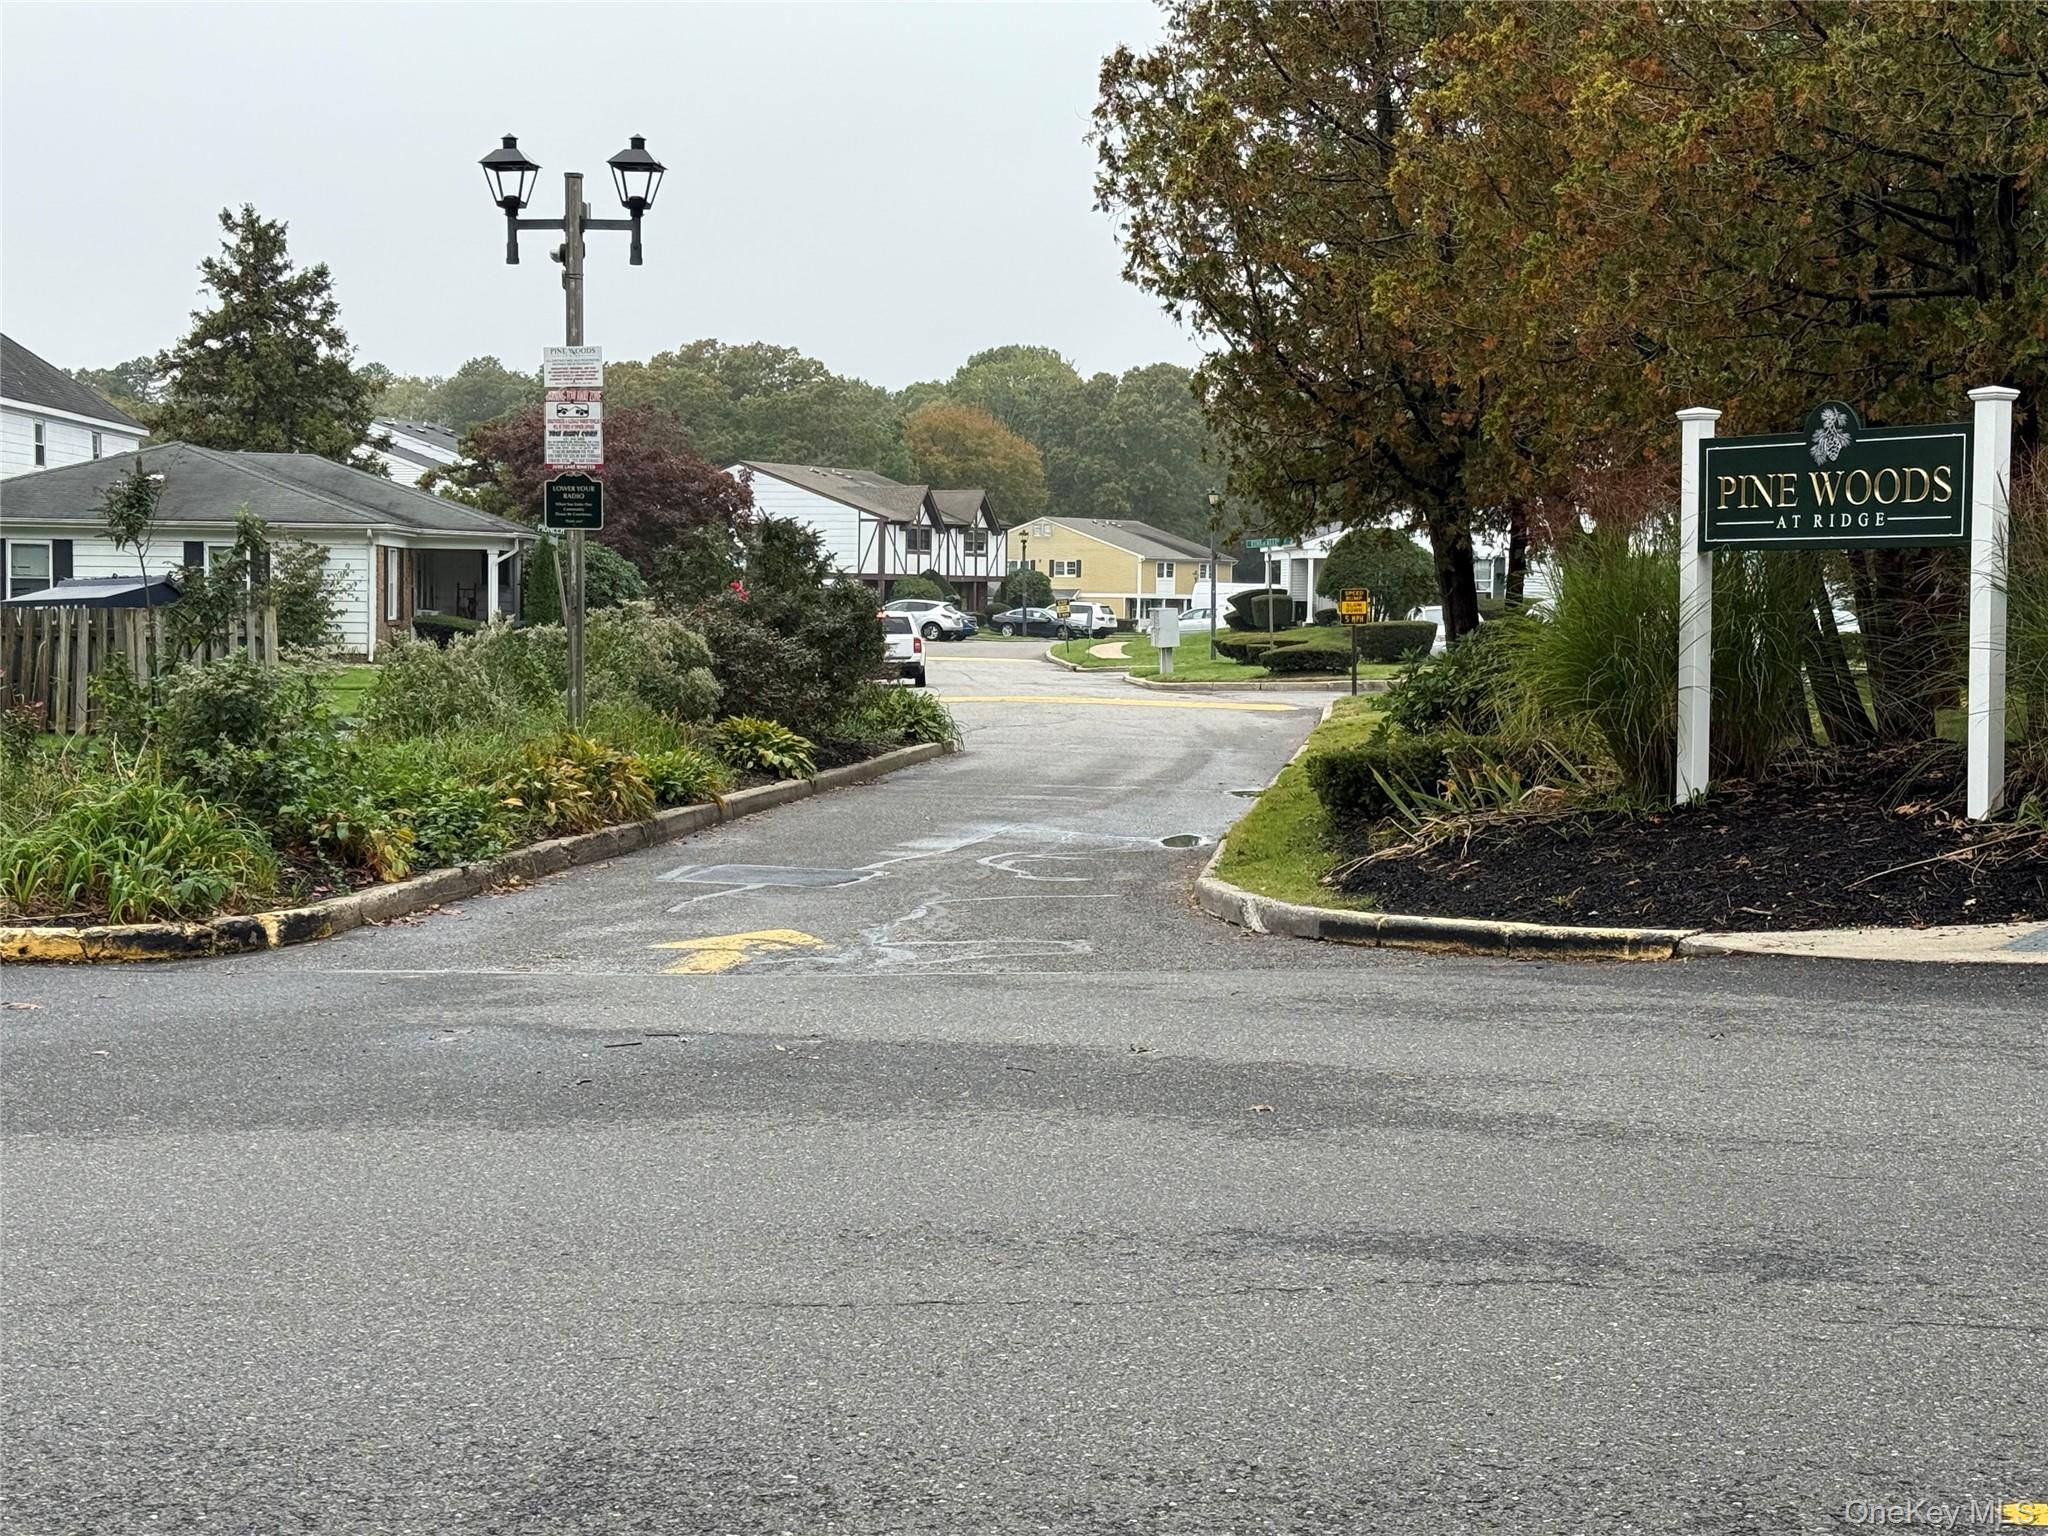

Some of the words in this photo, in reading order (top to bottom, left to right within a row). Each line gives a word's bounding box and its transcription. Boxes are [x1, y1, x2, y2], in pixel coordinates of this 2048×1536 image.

[1716, 473, 1799, 510] PINE
[1808, 465, 1953, 507] WOODS
[1776, 514, 1802, 529] AT
[1813, 512, 1886, 528] RIDGE
[1344, 615, 1350, 623] 5
[1351, 615, 1364, 623] MPH
